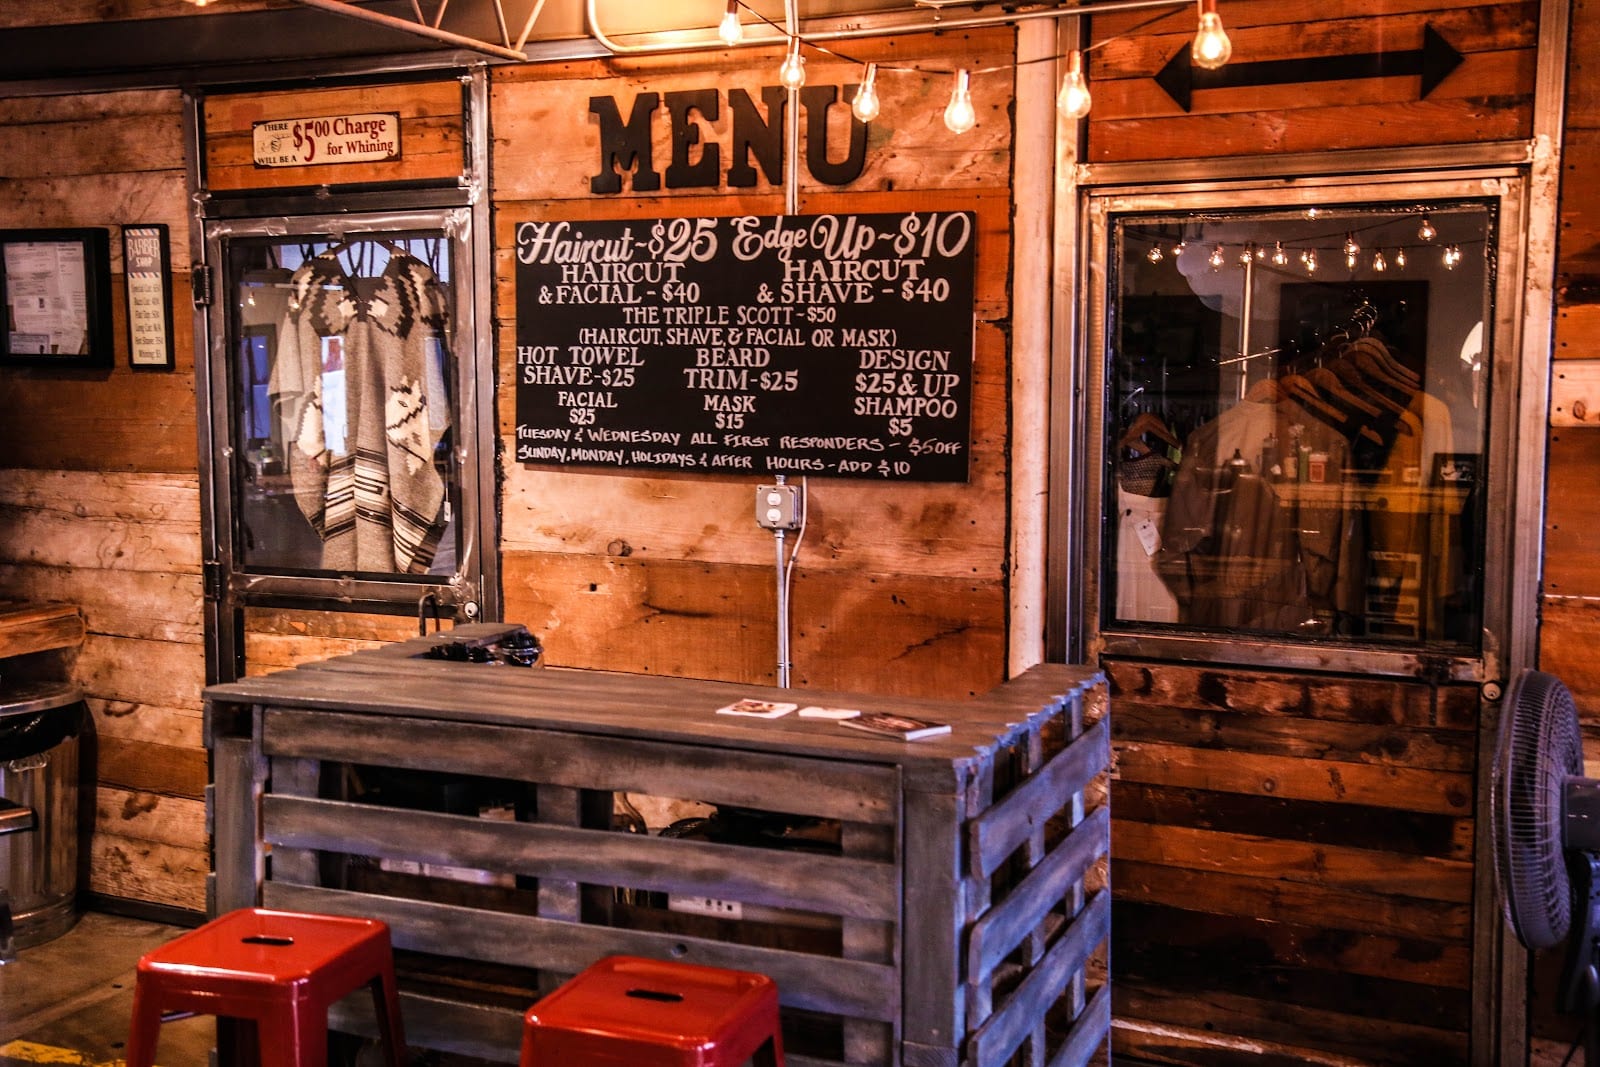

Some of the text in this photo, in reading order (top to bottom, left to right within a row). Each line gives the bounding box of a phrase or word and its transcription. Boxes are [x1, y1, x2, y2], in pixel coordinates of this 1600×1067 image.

[264, 123, 288, 132] THERE
[333, 118, 387, 139] Charge
[327, 139, 394, 156] for Whining
[589, 84, 868, 194] MENU
[128, 238, 160, 261] BARBER
[730, 216, 808, 263] Edge
[561, 262, 687, 284] HAIRCUT
[782, 259, 926, 282] HAIRCUT
[556, 284, 642, 304] FACIAL
[662, 282, 701, 303] $40
[757, 282, 775, 303] &
[781, 282, 874, 304] SHAVE
[902, 278, 950, 302] $40
[623, 307, 660, 324] THE
[663, 306, 730, 325] TRIPLE
[746, 328, 806, 346] FACIAL
[811, 329, 833, 346] OR
[842, 329, 898, 347] MASK)
[518, 346, 645, 366] HOT TOWEL
[696, 348, 770, 368] BEARD
[859, 350, 950, 371] DESIGN
[855, 370, 897, 394] $25
[923, 374, 960, 398] UP
[558, 391, 618, 408] FACIAL
[703, 395, 756, 413] MASK
[854, 397, 958, 419] SHAMPOO
[569, 408, 596, 425] $25
[714, 413, 745, 430] $15
[888, 417, 913, 436] $5
[516, 424, 571, 442] TUESDAY
[574, 428, 584, 442] &
[587, 429, 681, 446] WEDNESDAY
[690, 432, 717, 446] ALL
[723, 434, 770, 448] FIRST
[780, 436, 885, 451] RESPONDERS
[632, 450, 696, 468] HOLIDAYS
[712, 452, 753, 469] AFTER
